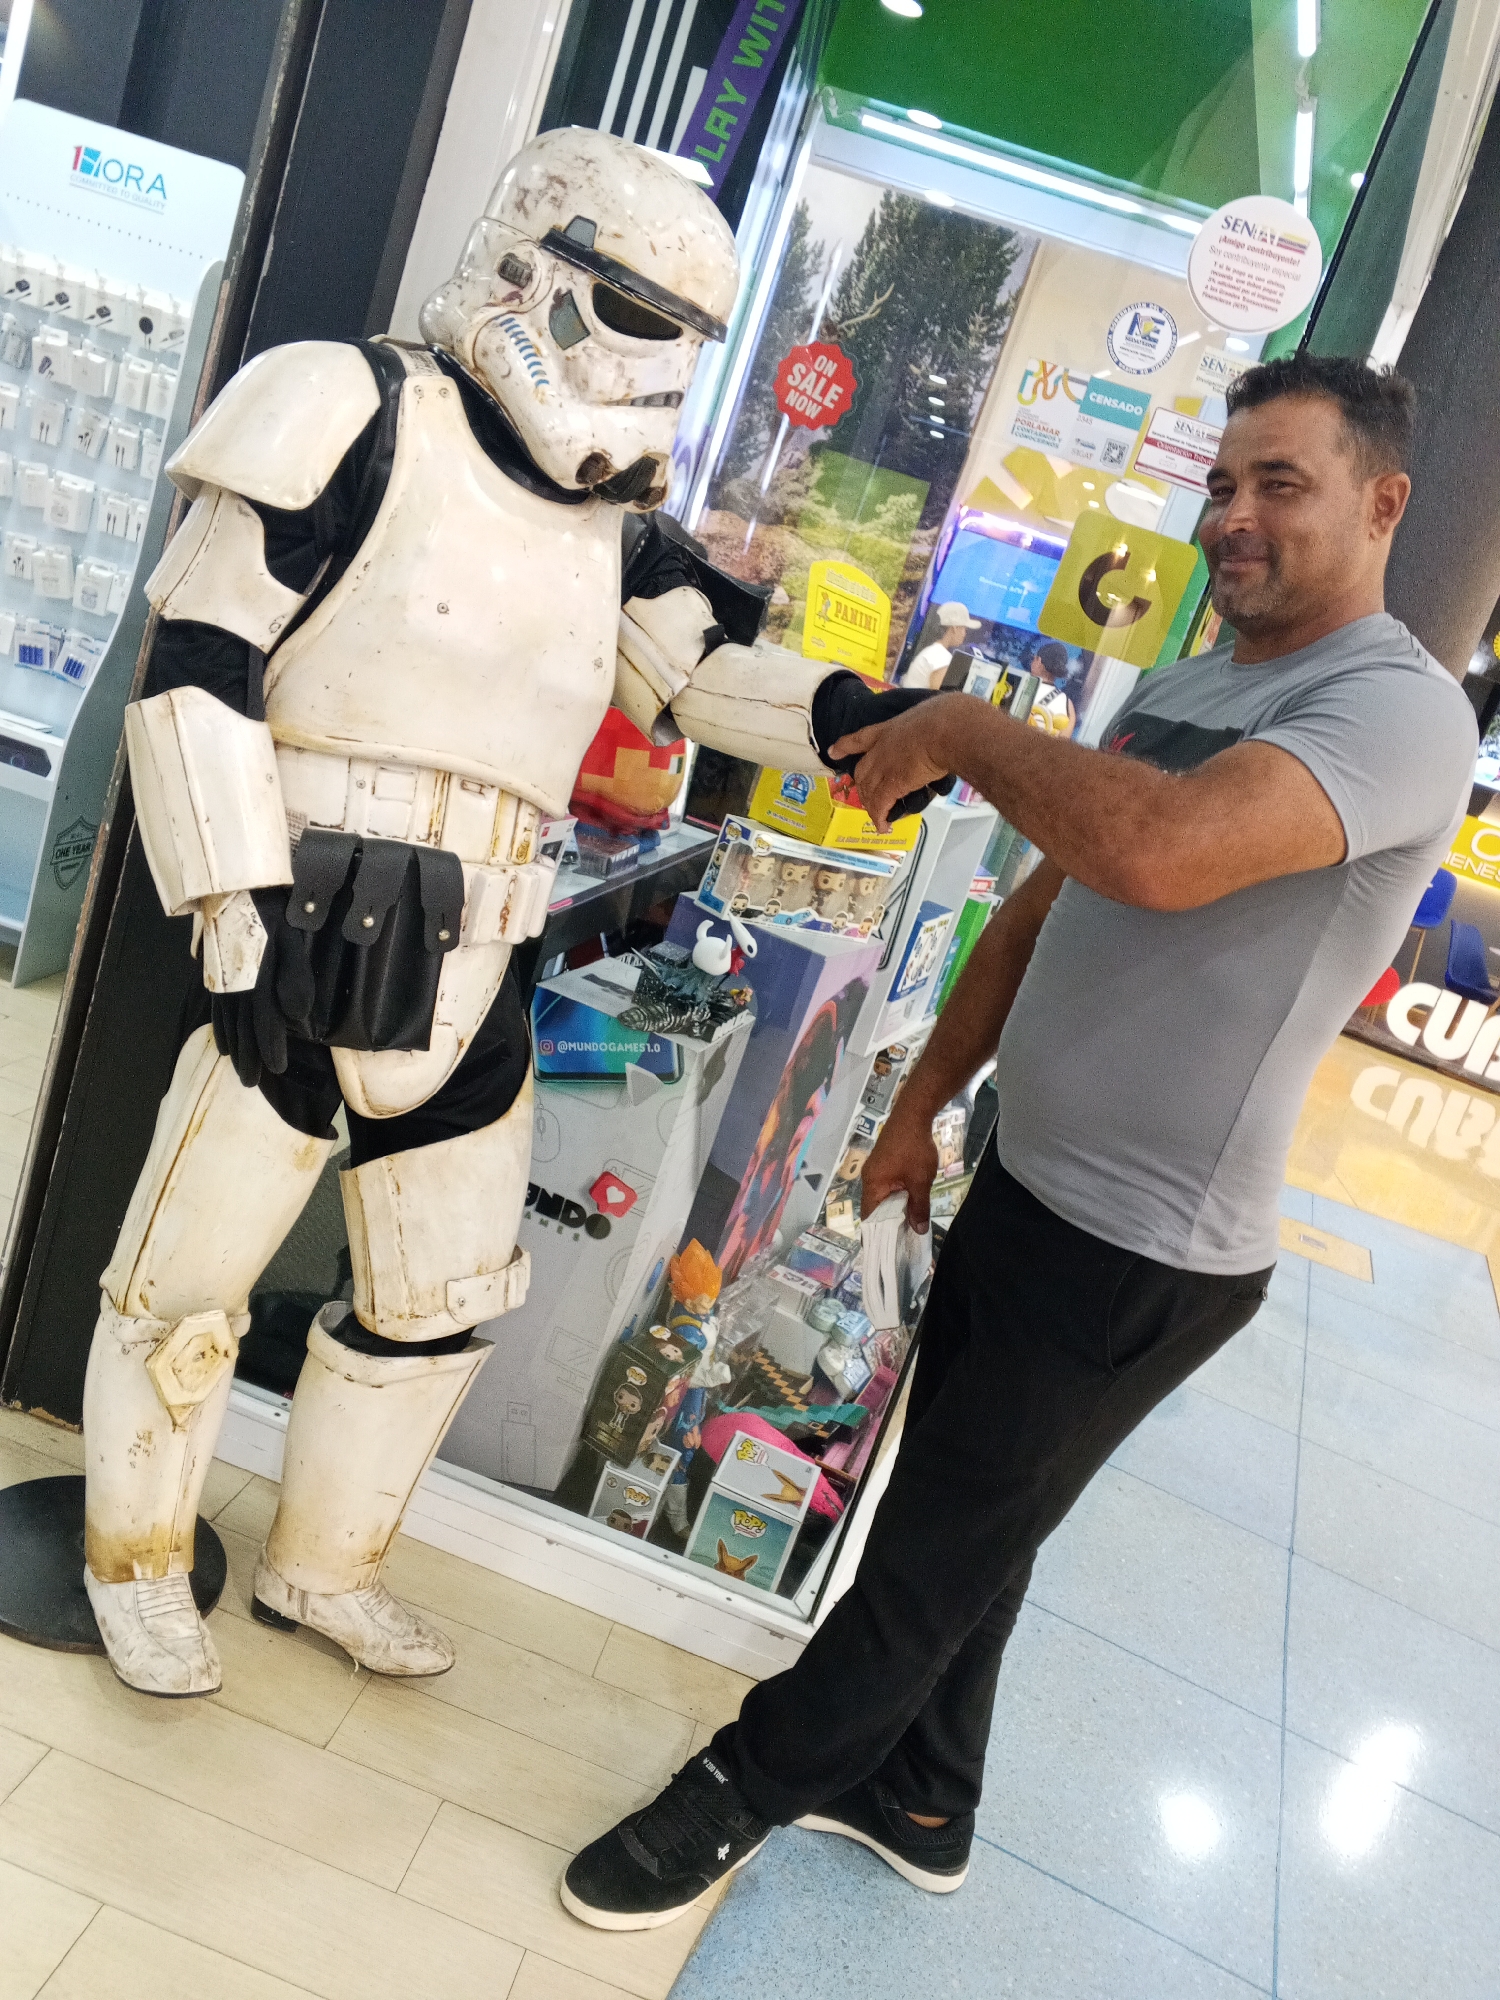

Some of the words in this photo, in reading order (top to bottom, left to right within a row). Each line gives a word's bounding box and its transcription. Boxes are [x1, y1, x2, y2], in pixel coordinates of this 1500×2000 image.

[121, 189, 130, 199] TO
[132, 194, 165, 210] QUALITY
[814, 355, 838, 378] ON
[787, 363, 844, 409] SALE
[785, 389, 822, 419] NOW
[1089, 391, 1144, 416] CENSADO
[1014, 417, 1060, 436] PORLAMAR
[834, 600, 878, 634] PANINI
[56, 845, 71, 859] ONE
[72, 841, 91, 855] YEAR
[557, 1040, 661, 1053] @MUNDOGAMES1.0
[732, 1509, 768, 1533] POP!
[713, 1769, 725, 1784] YORK
